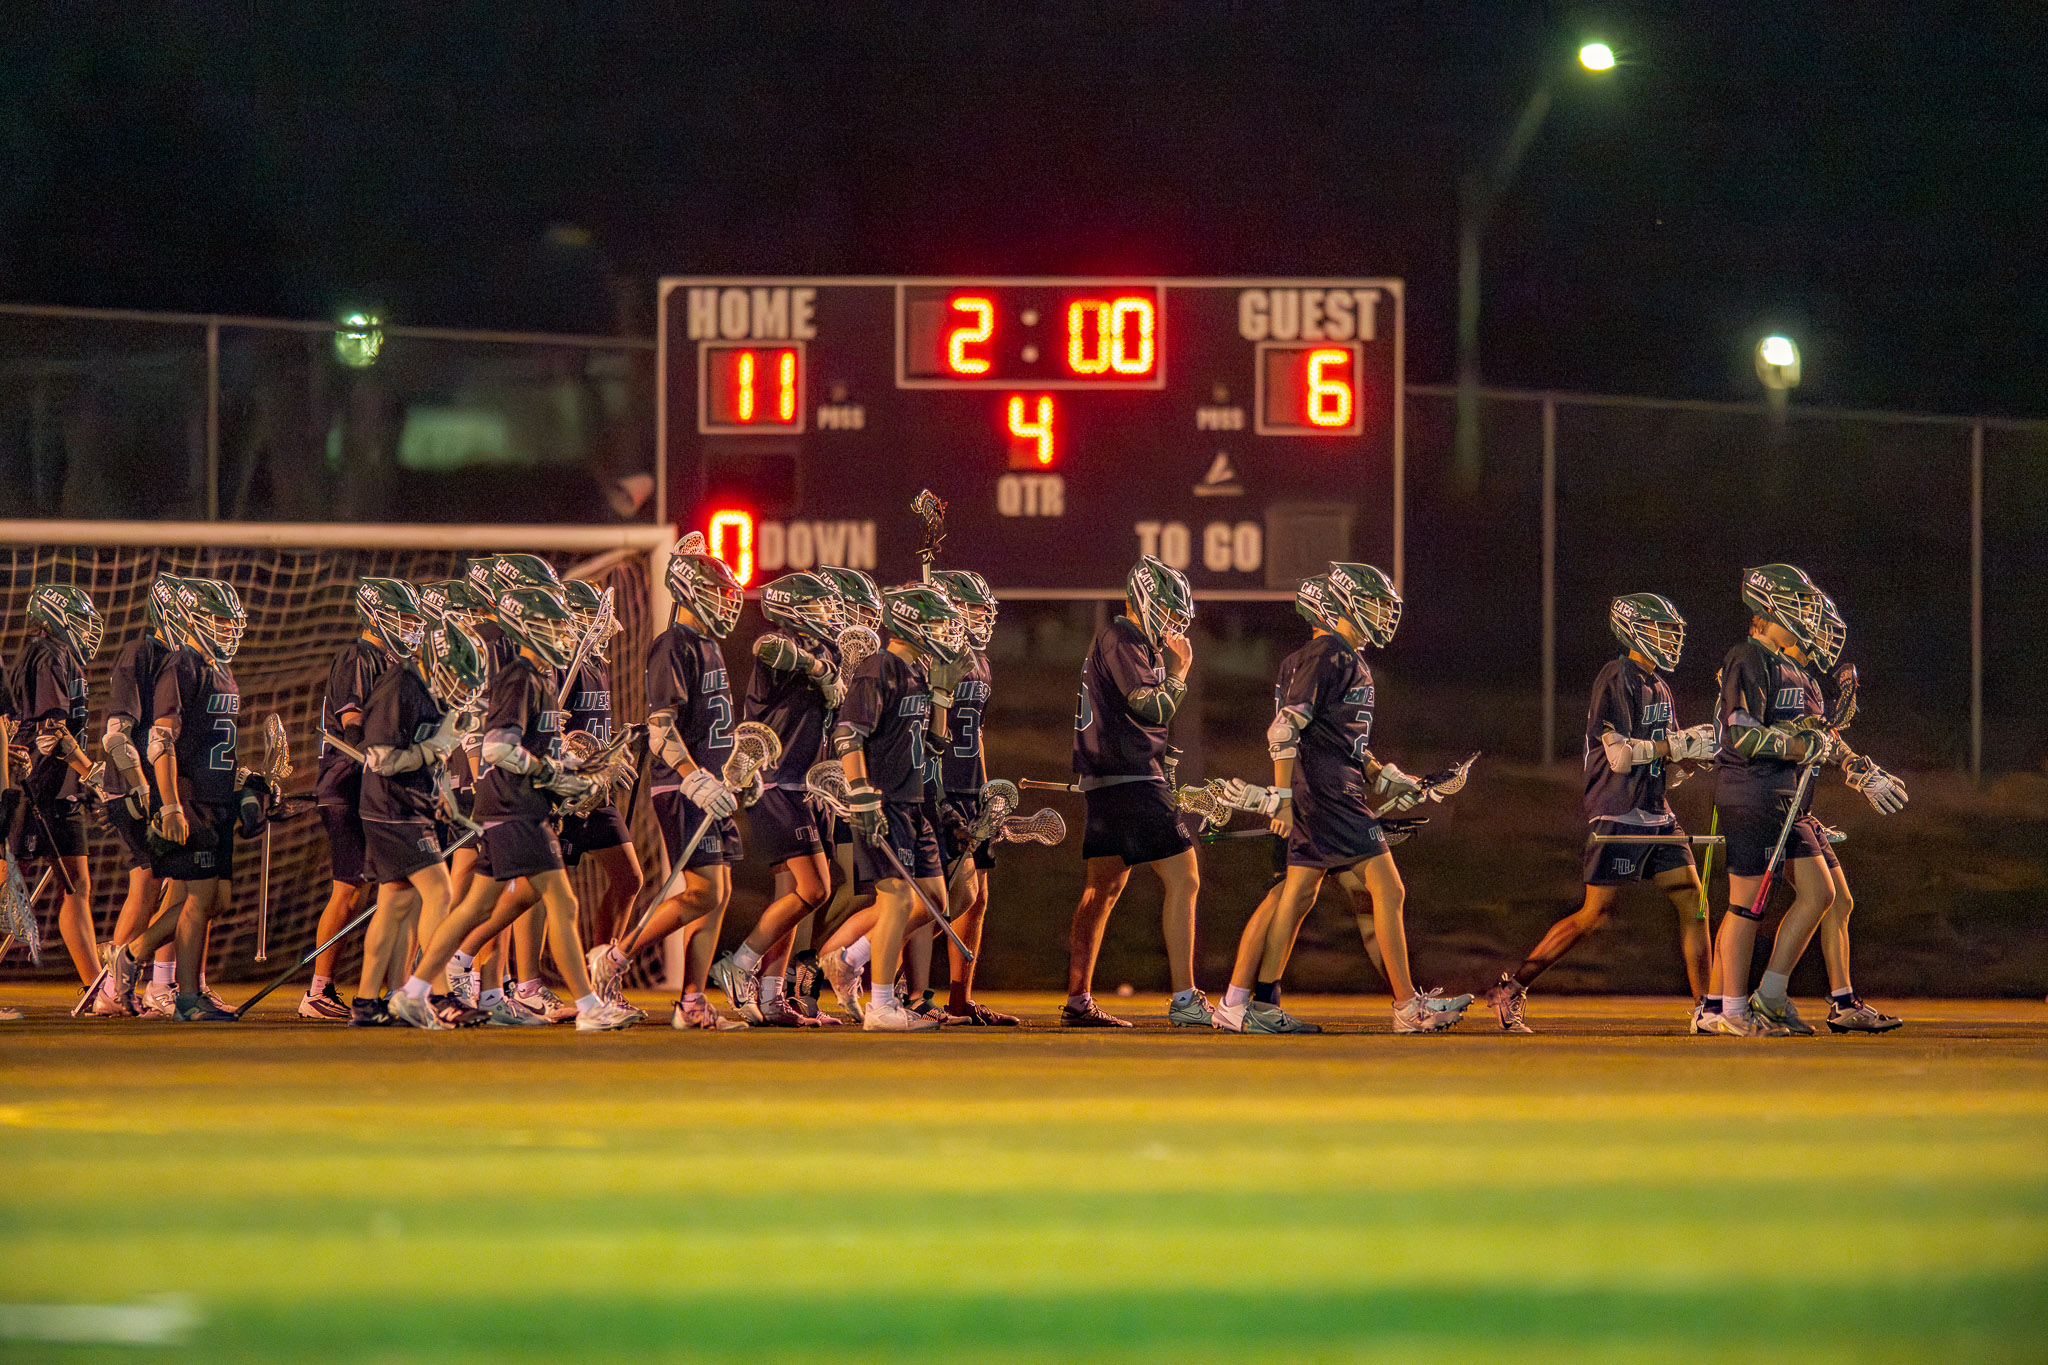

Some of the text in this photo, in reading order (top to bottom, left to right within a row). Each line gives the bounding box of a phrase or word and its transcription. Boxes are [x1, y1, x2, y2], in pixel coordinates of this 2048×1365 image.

[687, 287, 818, 341] HOME
[1237, 288, 1382, 342] GUEST
[737, 351, 797, 422] 11
[1306, 347, 1353, 427] 6
[1007, 394, 1054, 465] 4
[996, 472, 1066, 517] QTR
[708, 508, 754, 587] 0
[757, 520, 878, 571] DOWN
[1134, 520, 1264, 573] TO GO
[471, 564, 490, 581] CAT
[495, 559, 520, 581] CATS
[672, 557, 697, 580] CATS
[1137, 566, 1157, 593] CATS
[1330, 568, 1356, 591] CATS
[43, 587, 70, 609] CATS
[153, 579, 172, 604] CATS
[177, 584, 195, 608] CATS
[359, 583, 379, 605] CATS
[422, 588, 447, 607] CATS
[765, 587, 792, 604] CATS
[1300, 581, 1323, 600] CATS
[499, 593, 525, 617] CATS
[892, 600, 920, 621] CATS
[1613, 599, 1635, 618] CATS
[701, 667, 730, 694] WE
[206, 693, 240, 715] WE
[707, 694, 734, 750] 2
[952, 707, 981, 758] 3
[208, 718, 237, 771] 2
